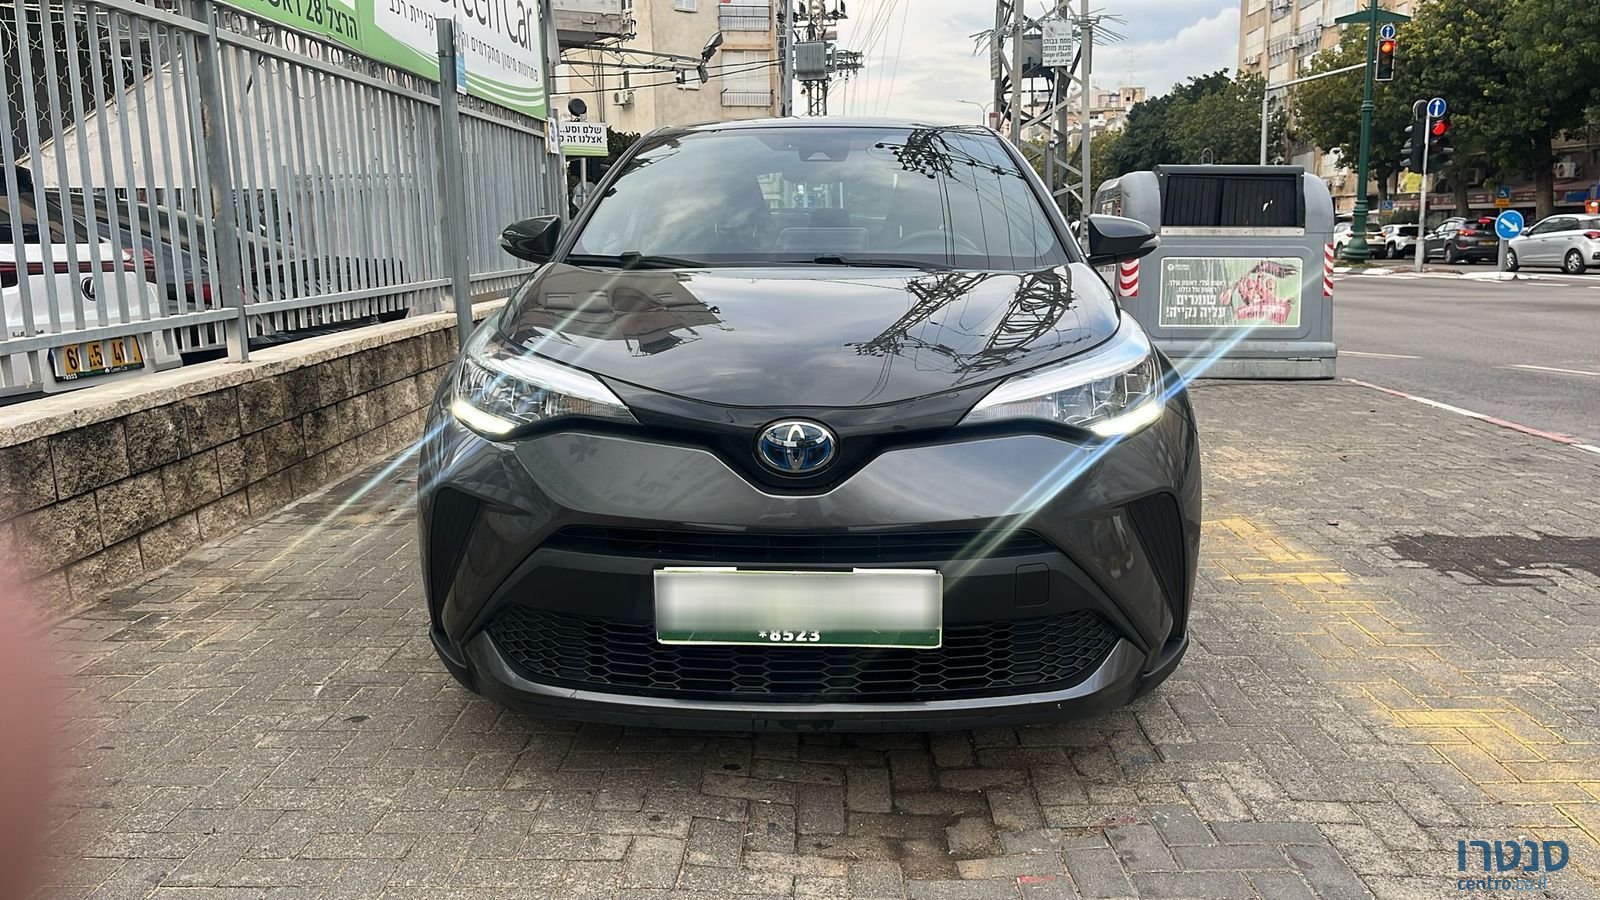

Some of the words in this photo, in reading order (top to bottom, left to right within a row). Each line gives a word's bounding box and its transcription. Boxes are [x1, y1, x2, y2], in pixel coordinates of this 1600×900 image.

[306, 0, 323, 25] 28
[325, 0, 358, 40] הרצל
[471, 37, 501, 64] מתקדמים
[582, 125, 602, 134] שלם
[567, 135, 577, 143] זה
[578, 134, 602, 143] אצלנו
[1176, 294, 1217, 305] שומרים
[1166, 306, 1198, 319] נקייה!
[1200, 306, 1226, 318] עליה
